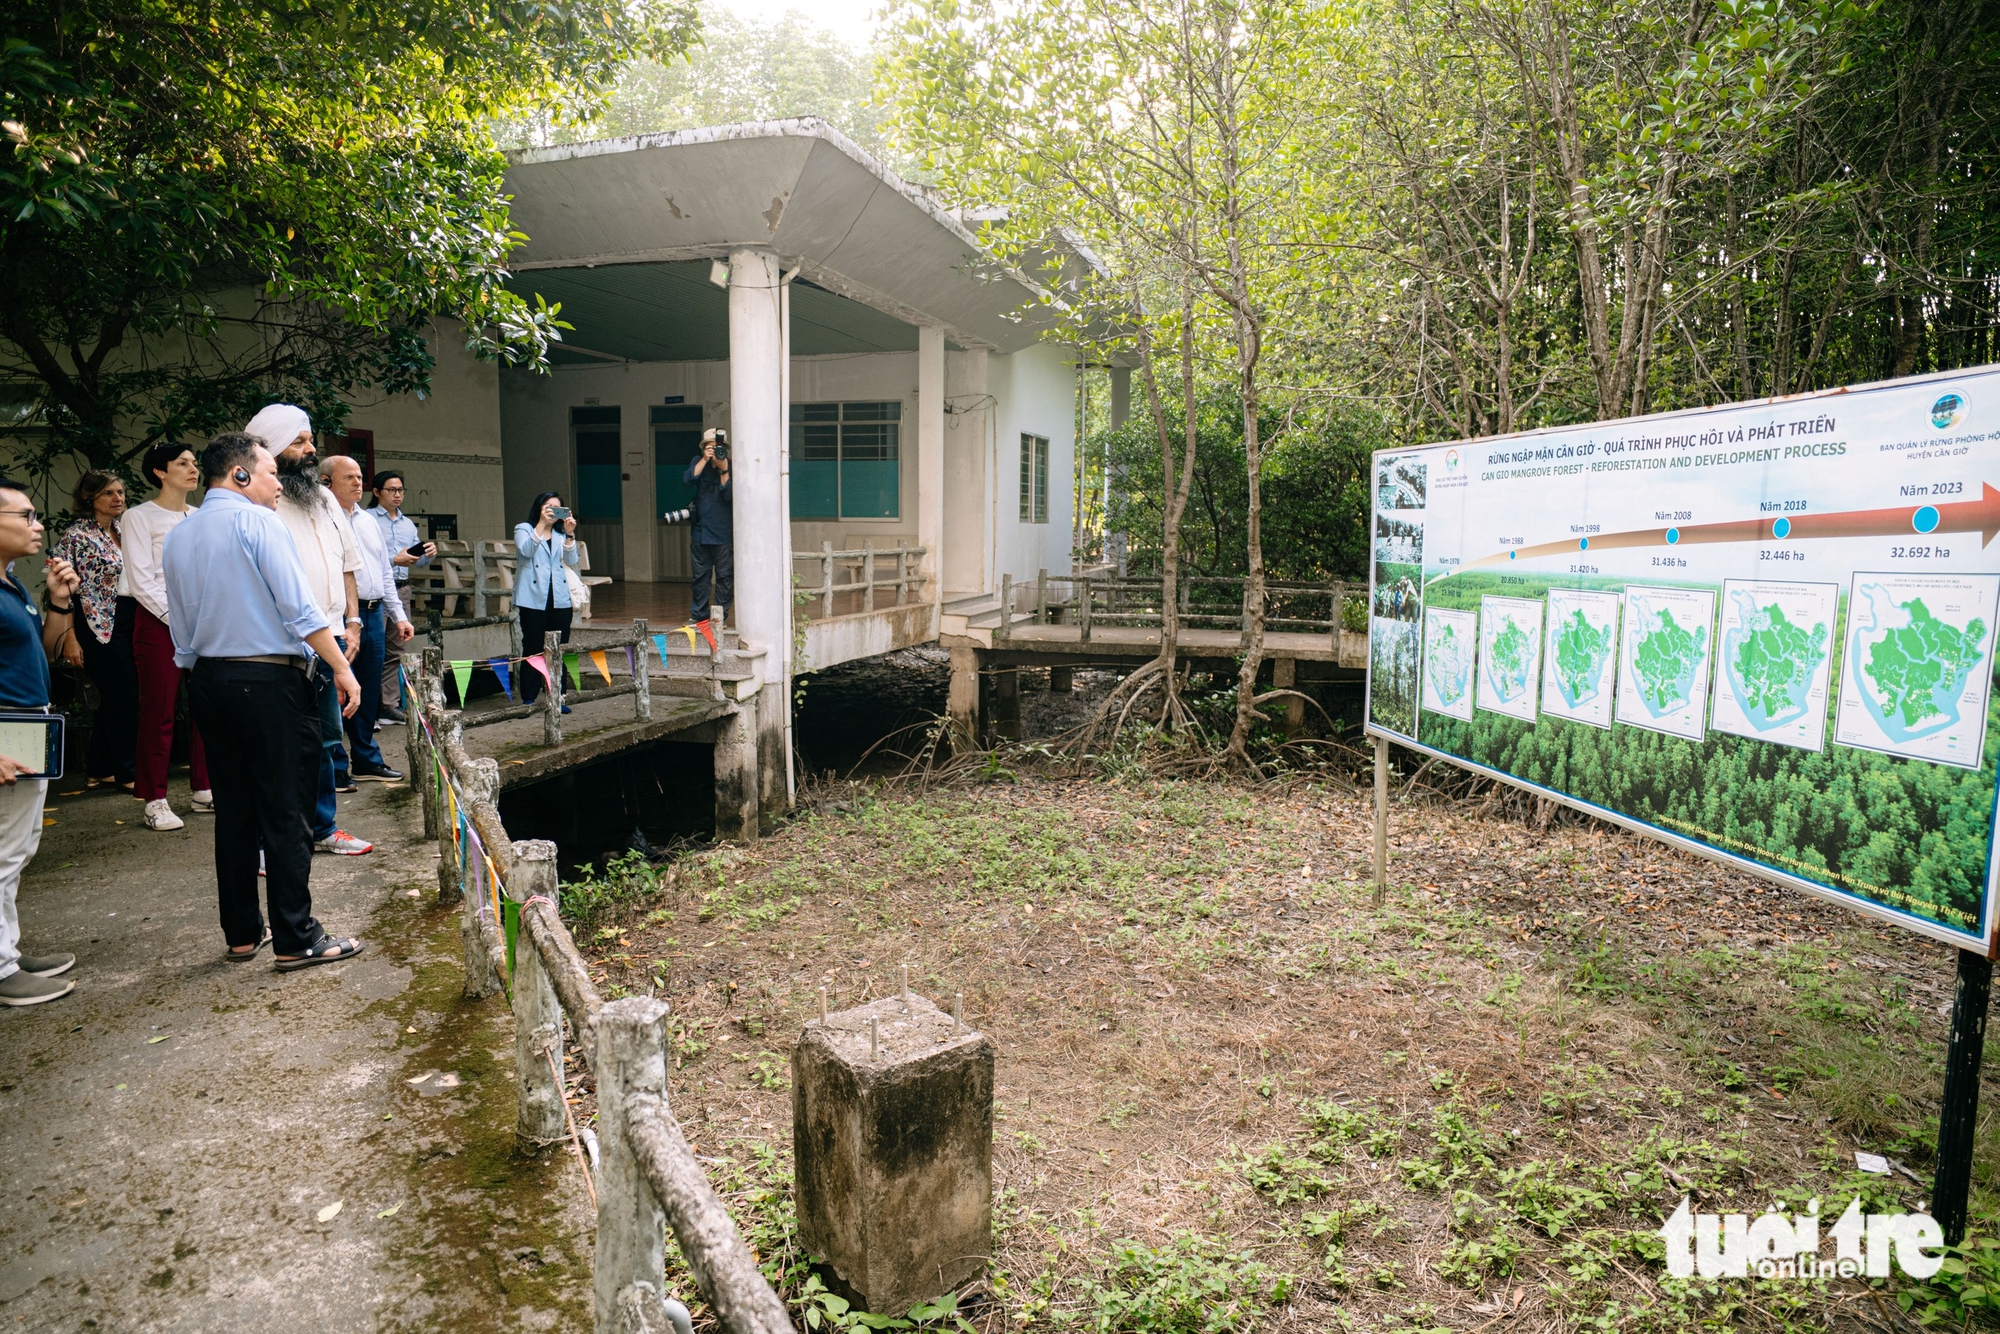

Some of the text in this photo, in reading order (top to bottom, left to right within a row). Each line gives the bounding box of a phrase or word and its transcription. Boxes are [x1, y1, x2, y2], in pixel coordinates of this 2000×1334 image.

[1488, 451, 1509, 464] RỪNG
[1512, 448, 1533, 464] NGẬP
[1536, 446, 1553, 463] MẶN
[1556, 444, 1574, 458] CẦN
[1577, 440, 1596, 456] GIỜ
[1604, 437, 1624, 455] QUÁ
[1628, 436, 1661, 452] TRÌNH
[1665, 435, 1696, 450] PHỤC
[1700, 429, 1723, 446] HỒI
[1728, 426, 1744, 443] VÀ
[1748, 421, 1785, 441] PHÁT
[1789, 414, 1836, 436] TRIỂN
[1880, 444, 1894, 452] BAN
[1896, 440, 1917, 450] QUẢN
[1920, 440, 1928, 448] LÝ
[1930, 436, 1953, 447] RỪNG
[1955, 434, 1985, 444] PHÒNG
[1907, 447, 1969, 460] HUYỆN CẦN GIỜ
[1482, 472, 1494, 481] CAN
[1496, 470, 1509, 480] GIO
[1511, 466, 1550, 478] MANGROVE
[1553, 464, 1584, 476] FOREST
[1592, 458, 1666, 472] REFORESTATION
[1670, 456, 1692, 468] AND
[1695, 448, 1780, 466] DEVELOPMENT
[1784, 442, 1846, 459] PROCESS
[1900, 482, 1962, 496] Năm 2023
[1760, 500, 1807, 512] Năm 2018
[1655, 511, 1692, 520] Năm 2008
[1586, 525, 1600, 533] 1998
[1760, 550, 1805, 561] 32.446 ha
[1891, 546, 1950, 558] 32.692 ha
[1652, 557, 1687, 567] 31.436 ha
[1570, 565, 1598, 574] 31.420 ha
[1501, 576, 1525, 585] 20.850 ha
[1776, 854, 1788, 862] Cao
[1790, 858, 1803, 868] Huy
[1822, 868, 1840, 879] Phan
[1857, 878, 1878, 893] Trung
[1880, 887, 1889, 895] và
[1891, 891, 1904, 900] Bùi
[1958, 911, 1977, 923] Kiệt
